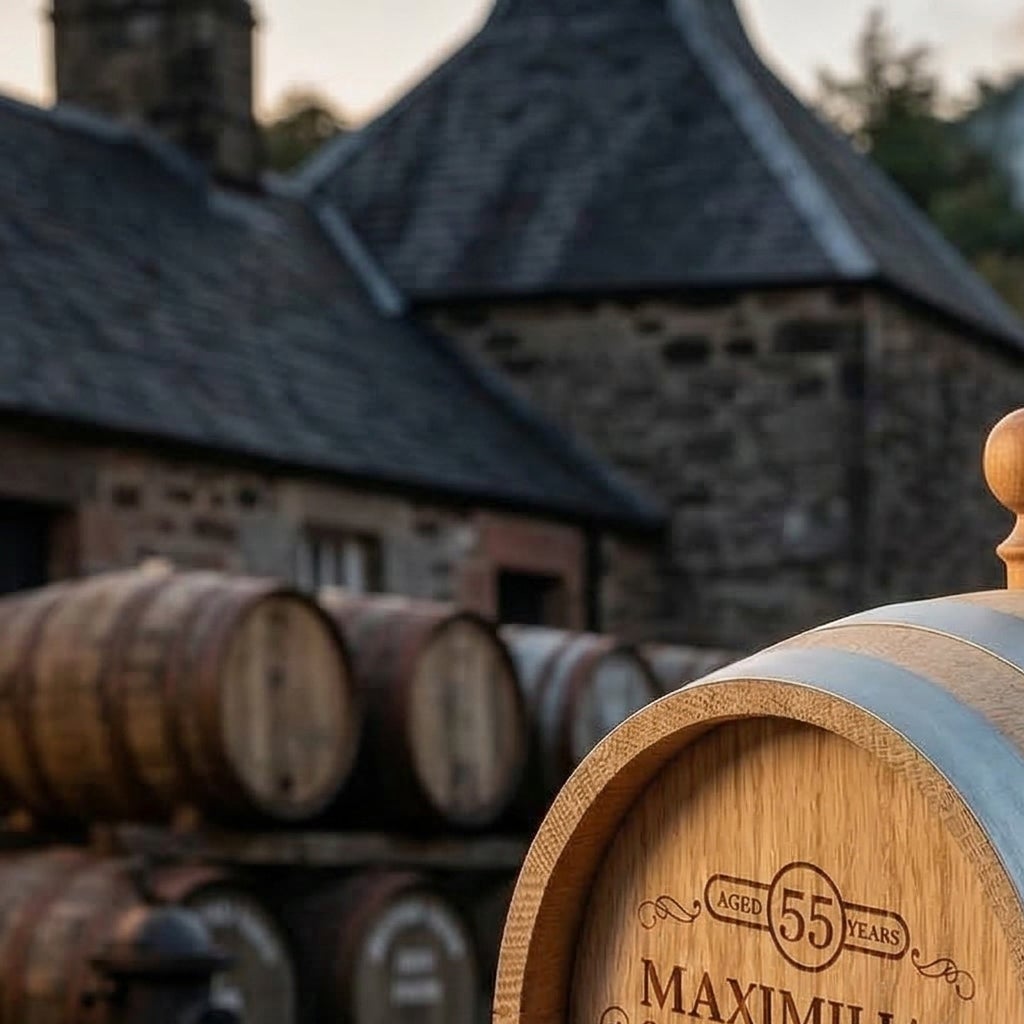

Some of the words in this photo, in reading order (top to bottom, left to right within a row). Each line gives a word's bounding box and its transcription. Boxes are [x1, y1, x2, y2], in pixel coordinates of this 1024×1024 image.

[717, 890, 763, 917] AGED
[779, 887, 834, 950] 55
[847, 918, 900, 947] YEARS
